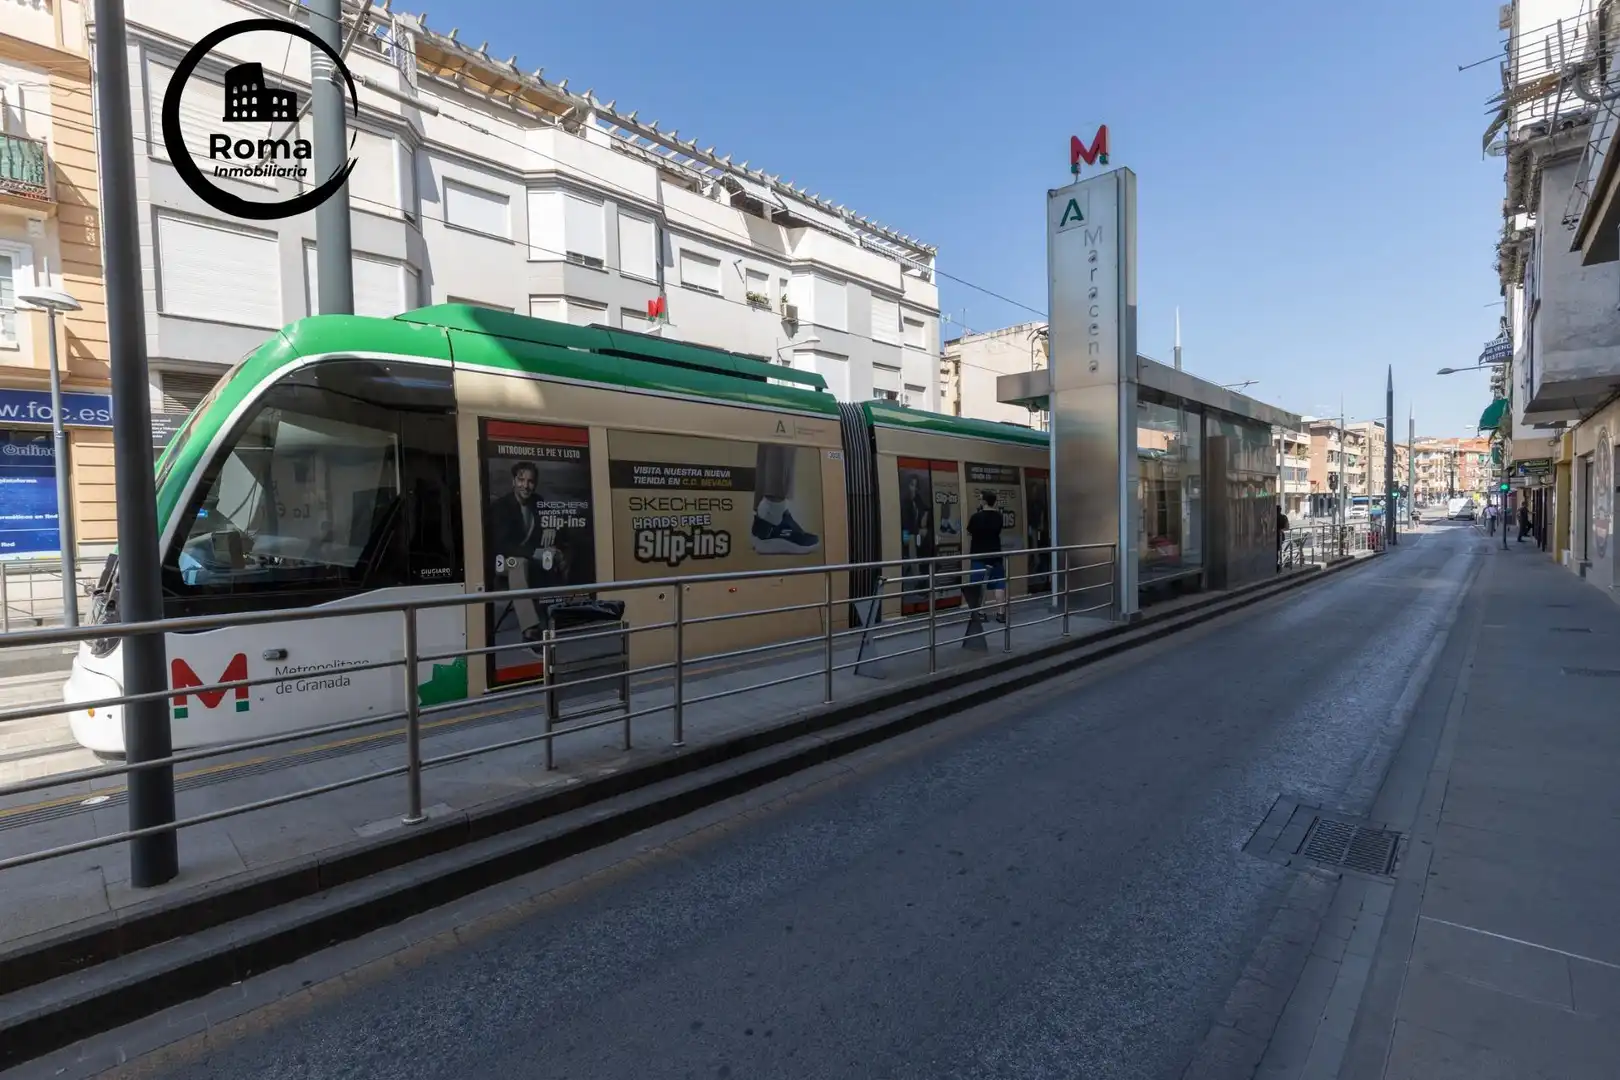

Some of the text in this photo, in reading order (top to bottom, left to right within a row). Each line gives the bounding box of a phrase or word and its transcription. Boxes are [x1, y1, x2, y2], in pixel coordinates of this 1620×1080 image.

[1083, 226, 1103, 374] Maracena
[497, 444, 581, 459] INTRODUCE EL PIE Y LISTO
[633, 466, 731, 478] VISITA NUESTRA NUEVA
[633, 476, 666, 486] TIENDA
[667, 477, 681, 486] EN
[536, 501, 588, 509] SKECHERS
[628, 496, 734, 512] SKECHERS
[541, 515, 587, 530] Slip-ins
[633, 514, 712, 530] HANDS FREE
[636, 528, 731, 565] Slip-ins
[275, 675, 351, 695] de Granada
